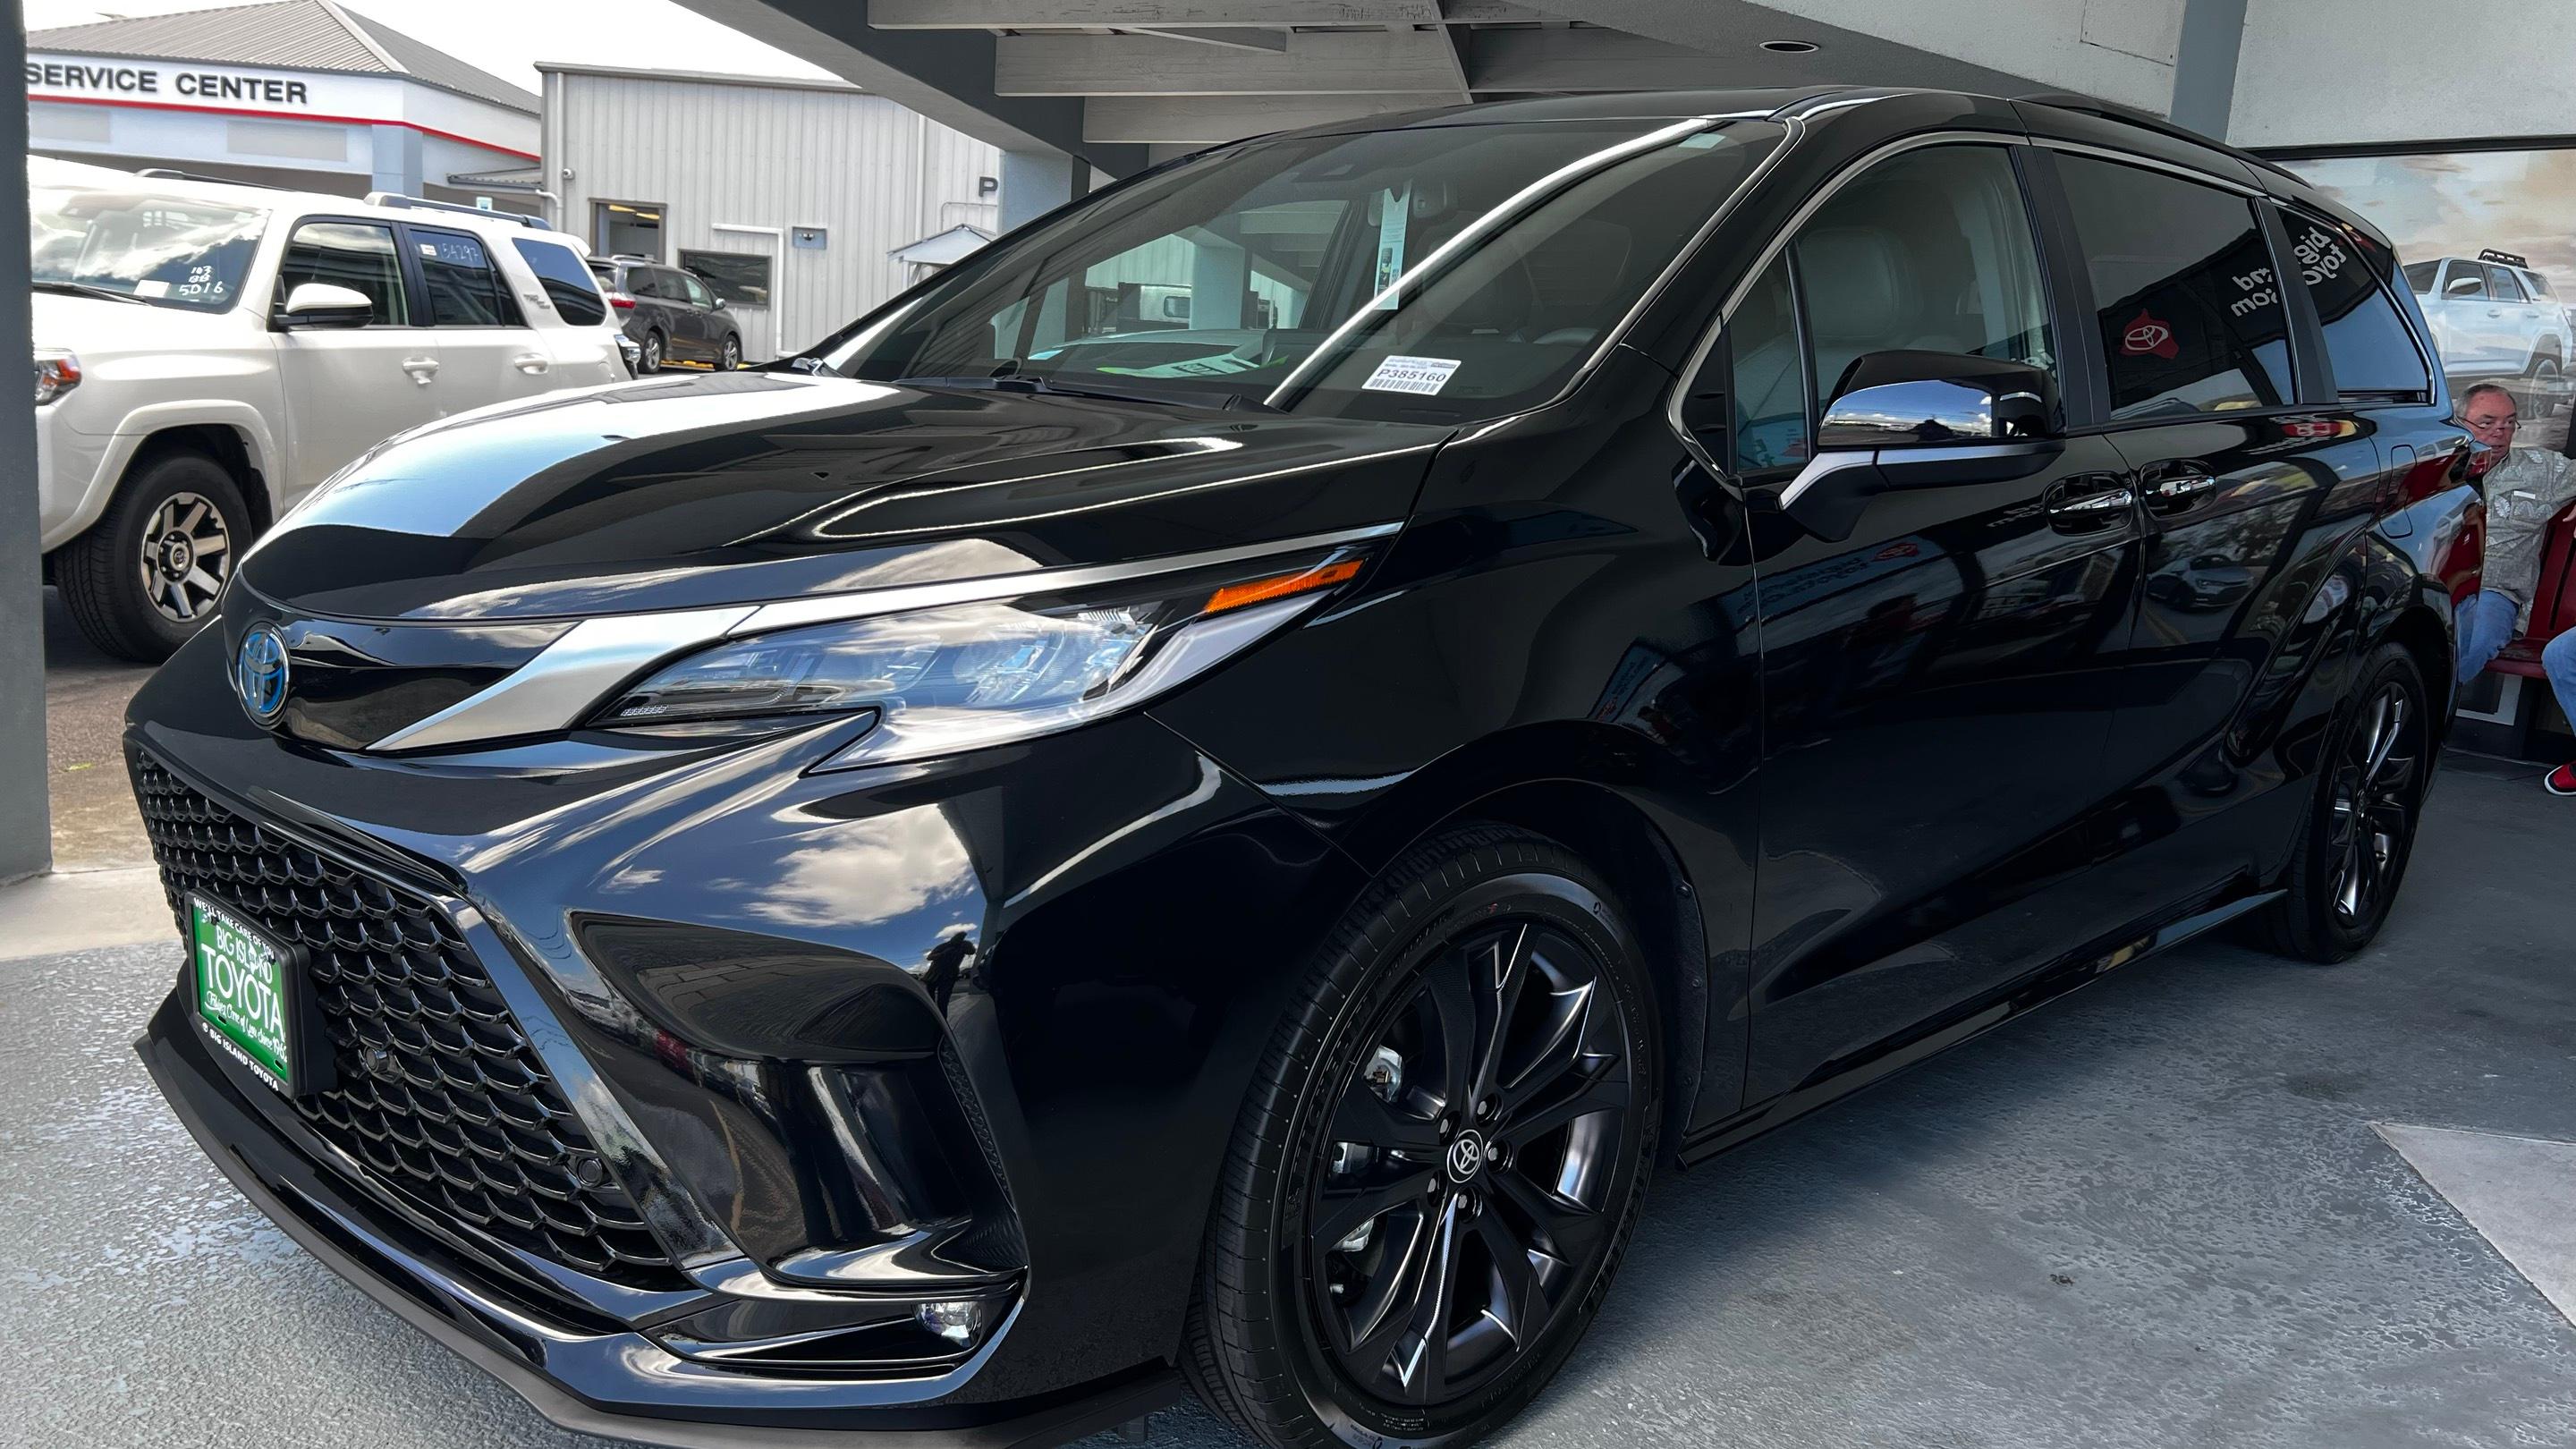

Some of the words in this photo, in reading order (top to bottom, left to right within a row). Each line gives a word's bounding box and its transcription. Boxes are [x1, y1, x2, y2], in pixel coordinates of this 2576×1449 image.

[25, 63, 157, 92] SERVICE
[175, 72, 308, 105] CENTER
[1377, 369, 1447, 383] P385160
[216, 911, 234, 928] TAKE
[234, 923, 251, 939] CARE
[252, 936, 262, 946] OF
[216, 924, 234, 956] BIG
[200, 943, 285, 1043] TOYOTA
[209, 1029, 222, 1045] BIG
[223, 1039, 248, 1065] ISLAND
[249, 1060, 279, 1091] TOYOTA
